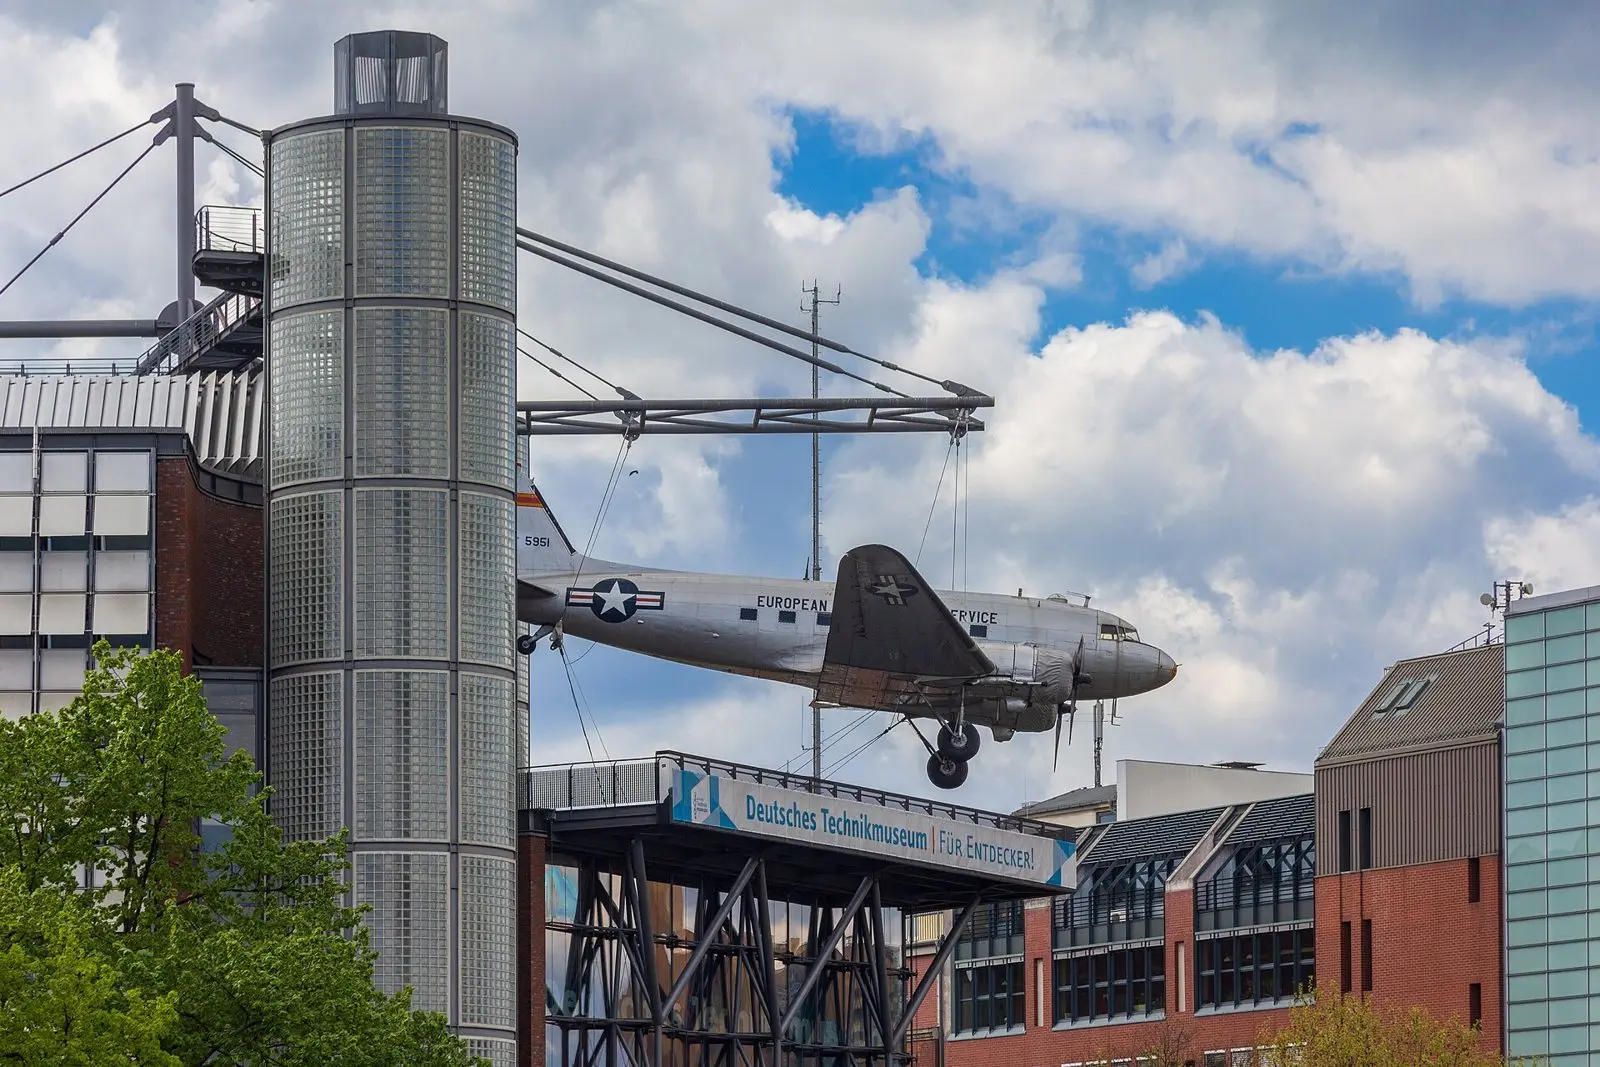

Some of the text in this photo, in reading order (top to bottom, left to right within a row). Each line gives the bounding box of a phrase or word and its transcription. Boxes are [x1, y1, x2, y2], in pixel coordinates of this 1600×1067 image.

[525, 536, 550, 548] 5951
[757, 595, 998, 625] EUROPEAN ERVICE
[746, 795, 817, 832] Deutsches
[821, 808, 928, 850] Technikmuseum
[940, 830, 963, 857] FÜR
[967, 835, 1035, 870] ENTDECKER!
